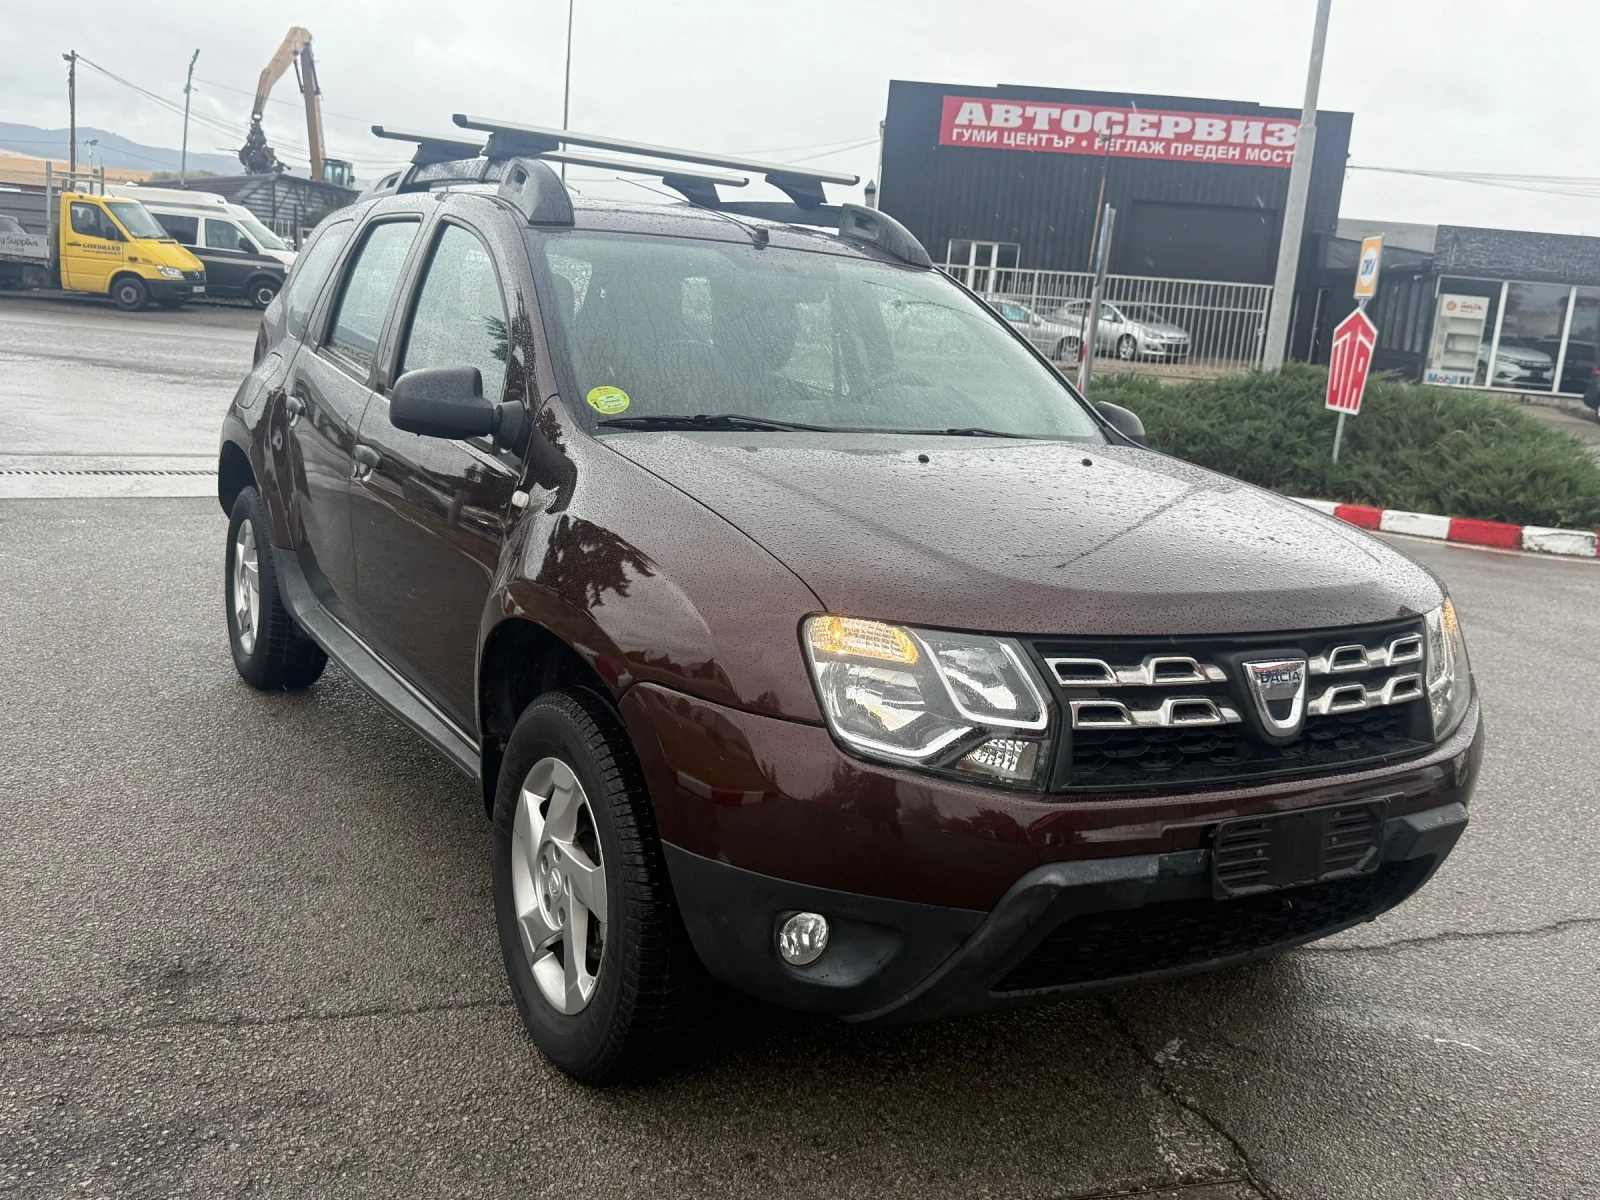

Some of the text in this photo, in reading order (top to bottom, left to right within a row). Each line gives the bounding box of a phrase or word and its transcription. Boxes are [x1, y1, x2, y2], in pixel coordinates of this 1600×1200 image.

[954, 102, 1297, 147] АВТОСЕРВИЗ
[952, 128, 1296, 164] ГУМИ ЦЕНТЪР РЕГЛАЖ ПРЕДЕН МОСТ
[7, 236, 39, 248] Supplies
[1361, 258, 1377, 276] DKV
[1428, 373, 1459, 385] Mobil
[1261, 671, 1300, 683] DACIA
